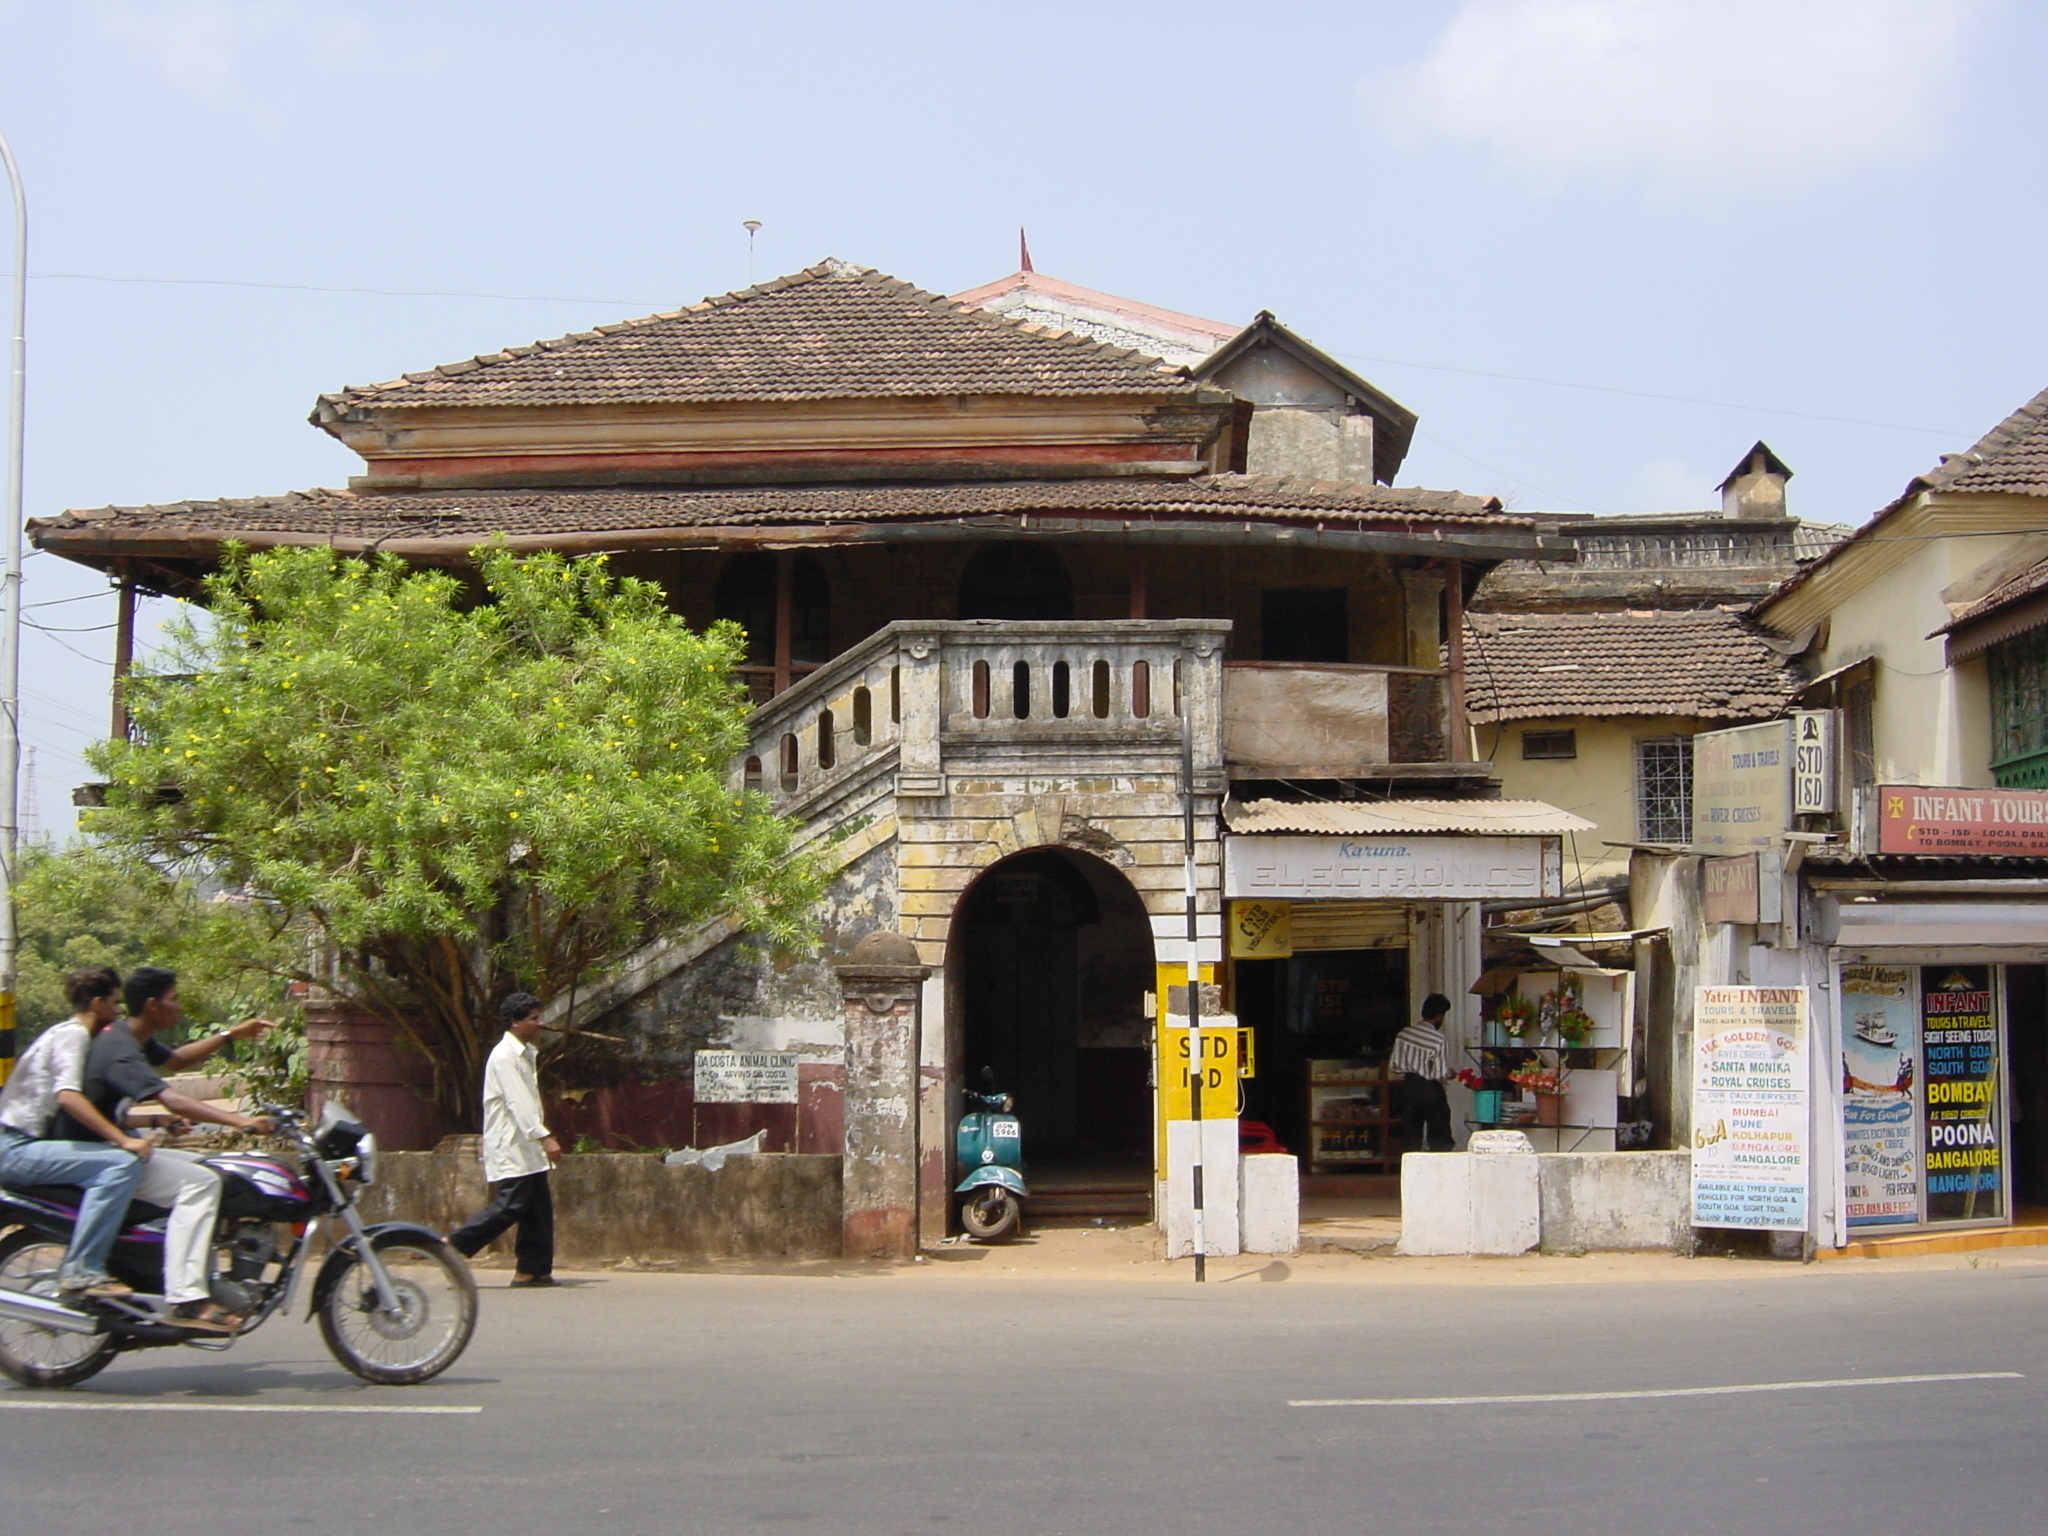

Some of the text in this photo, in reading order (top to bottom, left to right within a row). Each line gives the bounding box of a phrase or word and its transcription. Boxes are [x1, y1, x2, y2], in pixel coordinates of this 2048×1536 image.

[1797, 745, 1823, 775] STD
[1798, 777, 1822, 806] ISD
[1732, 807, 1761, 822] CRUISES
[1912, 796, 1984, 822] INFANT
[1918, 828, 1940, 836] STD
[1952, 828, 1970, 836] ISD
[1982, 829, 2018, 838] LOCAL
[2022, 830, 2048, 838] DAIL
[1919, 838, 1932, 846] TO
[1250, 861, 1537, 888] ELECTRONICS
[1708, 863, 1754, 892] INFANT
[1704, 990, 1731, 1003] Yatri
[1738, 989, 1803, 1003] INFANT
[1926, 991, 1990, 1014] INFANT
[1704, 1006, 1798, 1015] TOURS & TRAVELS
[1926, 1015, 1993, 1029] TOURS & TRAVELS
[1700, 1040, 1719, 1054] SEE
[1724, 1032, 1771, 1043] GOLDEN
[1924, 1029, 1996, 1044] SIGHT SEEING TOURS
[1178, 1036, 1228, 1058] STD
[1928, 1046, 1991, 1059] NORTH GOA
[697, 1055, 795, 1068] DA COSTA ANIMAL CLINIC
[1711, 1061, 1791, 1074] SANTA MONIKA
[1928, 1060, 1993, 1075] SOUTH GOA
[764, 1070, 786, 1078] COSTA
[1711, 1076, 1791, 1088] ROYAL CRUISES
[1928, 1081, 1995, 1104] BOMBAY
[1732, 1108, 1779, 1117] MUMBAI
[1732, 1120, 1762, 1128] PUNE
[1732, 1132, 1792, 1141] KOLHAPUR
[1930, 1122, 1994, 1147] POONA
[1708, 1146, 1718, 1158] TO
[1732, 1142, 1800, 1152] BANGALORE
[1926, 1148, 2000, 1170] BANGALORE
[1733, 1184, 1744, 1192] ALL
[1927, 1172, 2000, 1194] MANGALORE
[1743, 1204, 1764, 1212] SIGHT
